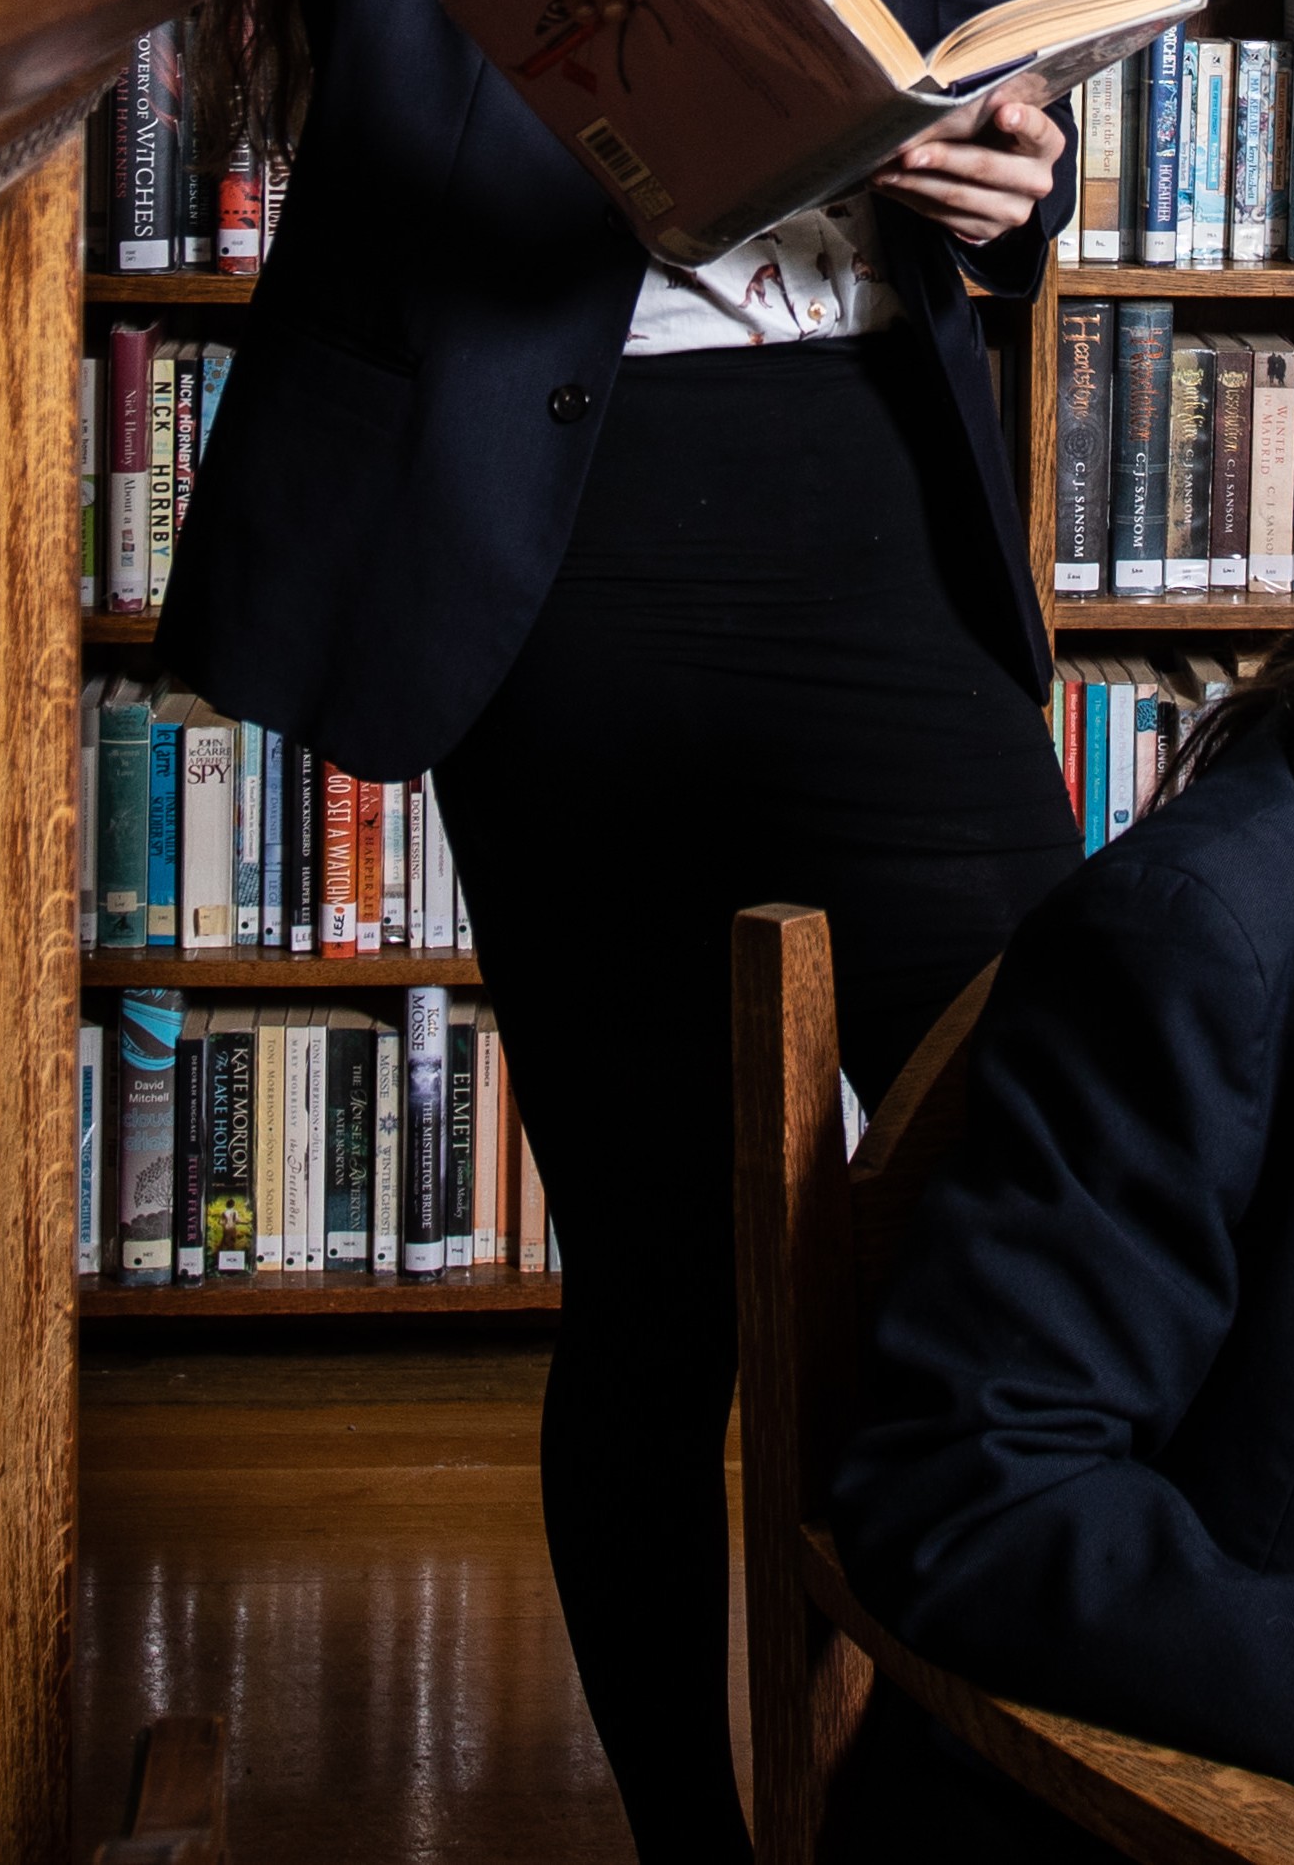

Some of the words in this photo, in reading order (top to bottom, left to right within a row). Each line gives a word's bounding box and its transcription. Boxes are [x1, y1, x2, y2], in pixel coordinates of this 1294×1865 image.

[137, 98, 149, 119] OF
[114, 109, 128, 199] HARKNESS
[134, 118, 159, 237] WITCHES
[1157, 164, 1173, 222] HOGFATHER
[124, 390, 137, 417] Nick
[154, 381, 171, 432] NICK
[179, 374, 194, 407] NICK
[177, 414, 193, 472] HORNBY
[1259, 413, 1272, 475] MADRID
[1274, 406, 1288, 465] WINTER
[123, 478, 135, 509] About
[152, 464, 171, 557] HORNBY
[1184, 474, 1194, 525] SANSOM
[1224, 484, 1235, 533] SANSOM
[1074, 496, 1085, 558] SANSOM
[1133, 486, 1145, 548] SANSOM
[187, 764, 231, 785] SPY
[302, 754, 310, 776] KILL
[302, 787, 310, 856] MOCKINGBIRD
[327, 800, 350, 822] SET
[411, 800, 421, 833] DORIS
[327, 829, 350, 838] A
[364, 836, 375, 890] HARPER
[411, 836, 420, 880] LESSING
[302, 866, 310, 904] HARPER
[363, 896, 375, 919] LEE
[411, 995, 425, 1051] MOSSE
[426, 1008, 439, 1038] Kate
[232, 1047, 249, 1092] KATE
[266, 1039, 275, 1064] TONI
[312, 1039, 321, 1065] TONI
[128, 1092, 170, 1104] Mitchell
[133, 1079, 164, 1092] David
[214, 1075, 228, 1115] LAKE
[266, 1069, 275, 1125] MORRISON
[311, 1069, 321, 1125] MORRISON
[380, 1054, 390, 1098] MOSSE
[335, 1109, 345, 1135] KATE
[422, 1101, 432, 1124] THE
[452, 1072, 471, 1154] ELMET
[213, 1120, 228, 1174] HOUSE
[228, 1098, 249, 1178] MORTON
[421, 1127, 433, 1191] MISTLETOE
[188, 1157, 199, 1195] TULIP
[334, 1137, 345, 1186] MORTON
[187, 1200, 199, 1241] FEVER
[421, 1194, 433, 1229] BRIDE
